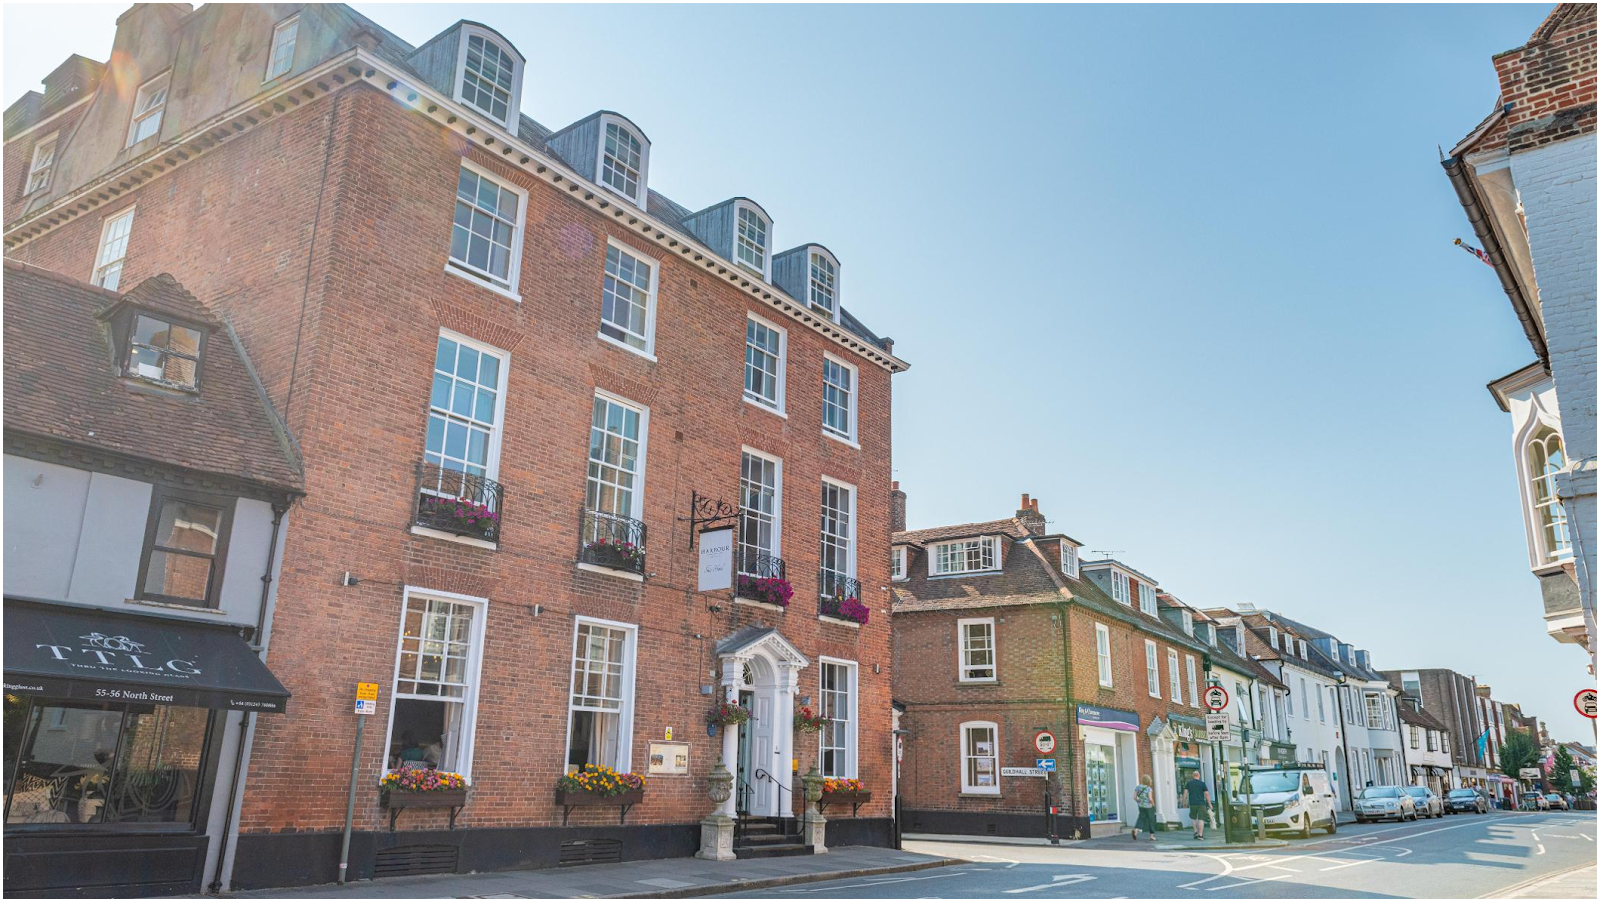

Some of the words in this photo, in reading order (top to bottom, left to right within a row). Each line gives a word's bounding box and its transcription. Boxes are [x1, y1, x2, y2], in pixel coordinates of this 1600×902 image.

[700, 545, 730, 555] HARBOUR
[36, 644, 202, 676] TTLG
[95, 688, 121, 698] 55-56
[122, 690, 148, 700] North
[149, 693, 174, 702] Street
